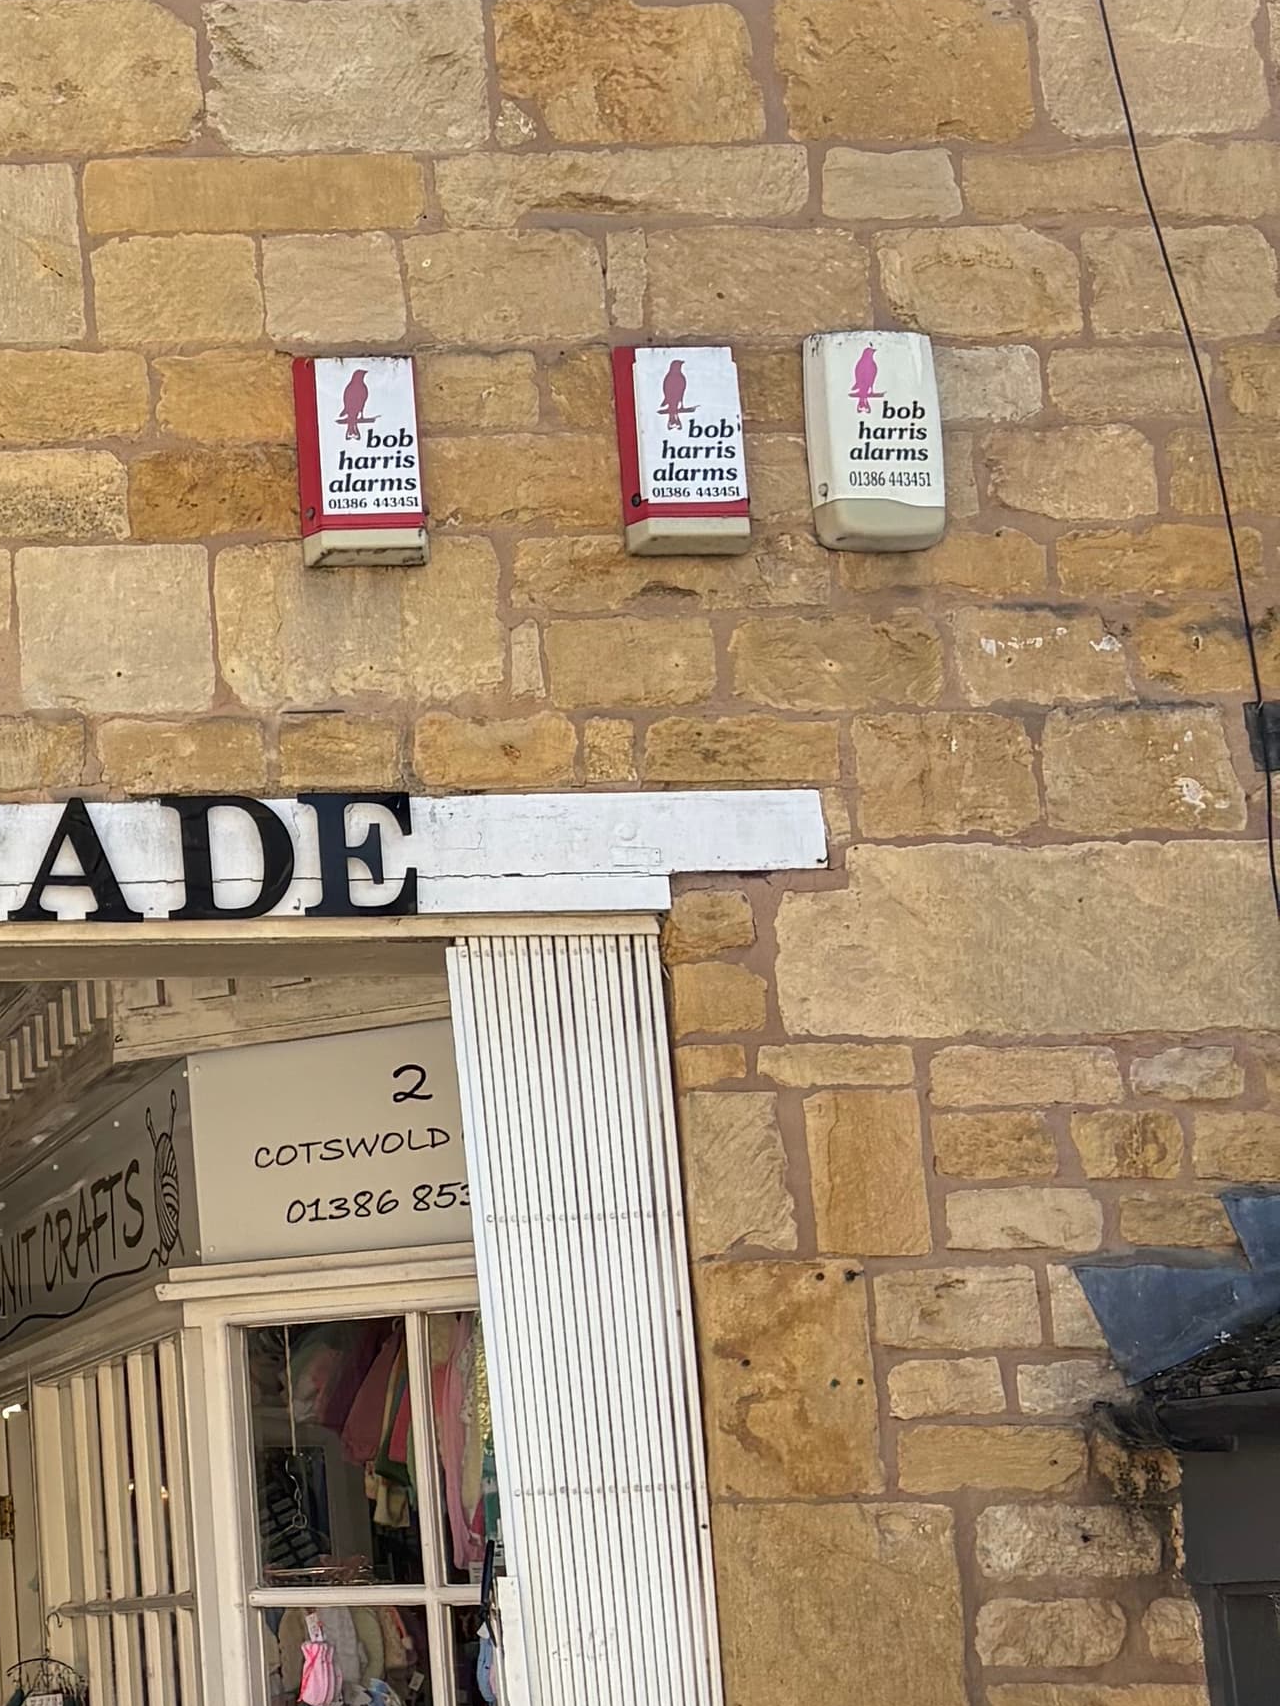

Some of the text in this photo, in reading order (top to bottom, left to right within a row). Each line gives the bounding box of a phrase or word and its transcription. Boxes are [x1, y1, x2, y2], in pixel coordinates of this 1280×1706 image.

[882, 401, 926, 419] bob
[366, 428, 414, 448] bob
[688, 419, 735, 438] bob
[858, 421, 927, 440] harris
[662, 440, 736, 460] harris
[850, 442, 929, 461] alarms
[339, 450, 415, 470] harris
[653, 463, 738, 482] alarms
[849, 471, 931, 487] 01386 443451
[329, 473, 417, 493] alarms
[652, 486, 740, 498] 01386 443451
[328, 496, 419, 509] 01386 443451
[393, 1064, 433, 1103] 2
[254, 1127, 450, 1168] COTSWOLD
[287, 1189, 399, 1224] 01386
[43, 1159, 145, 1292] CRAFTS
